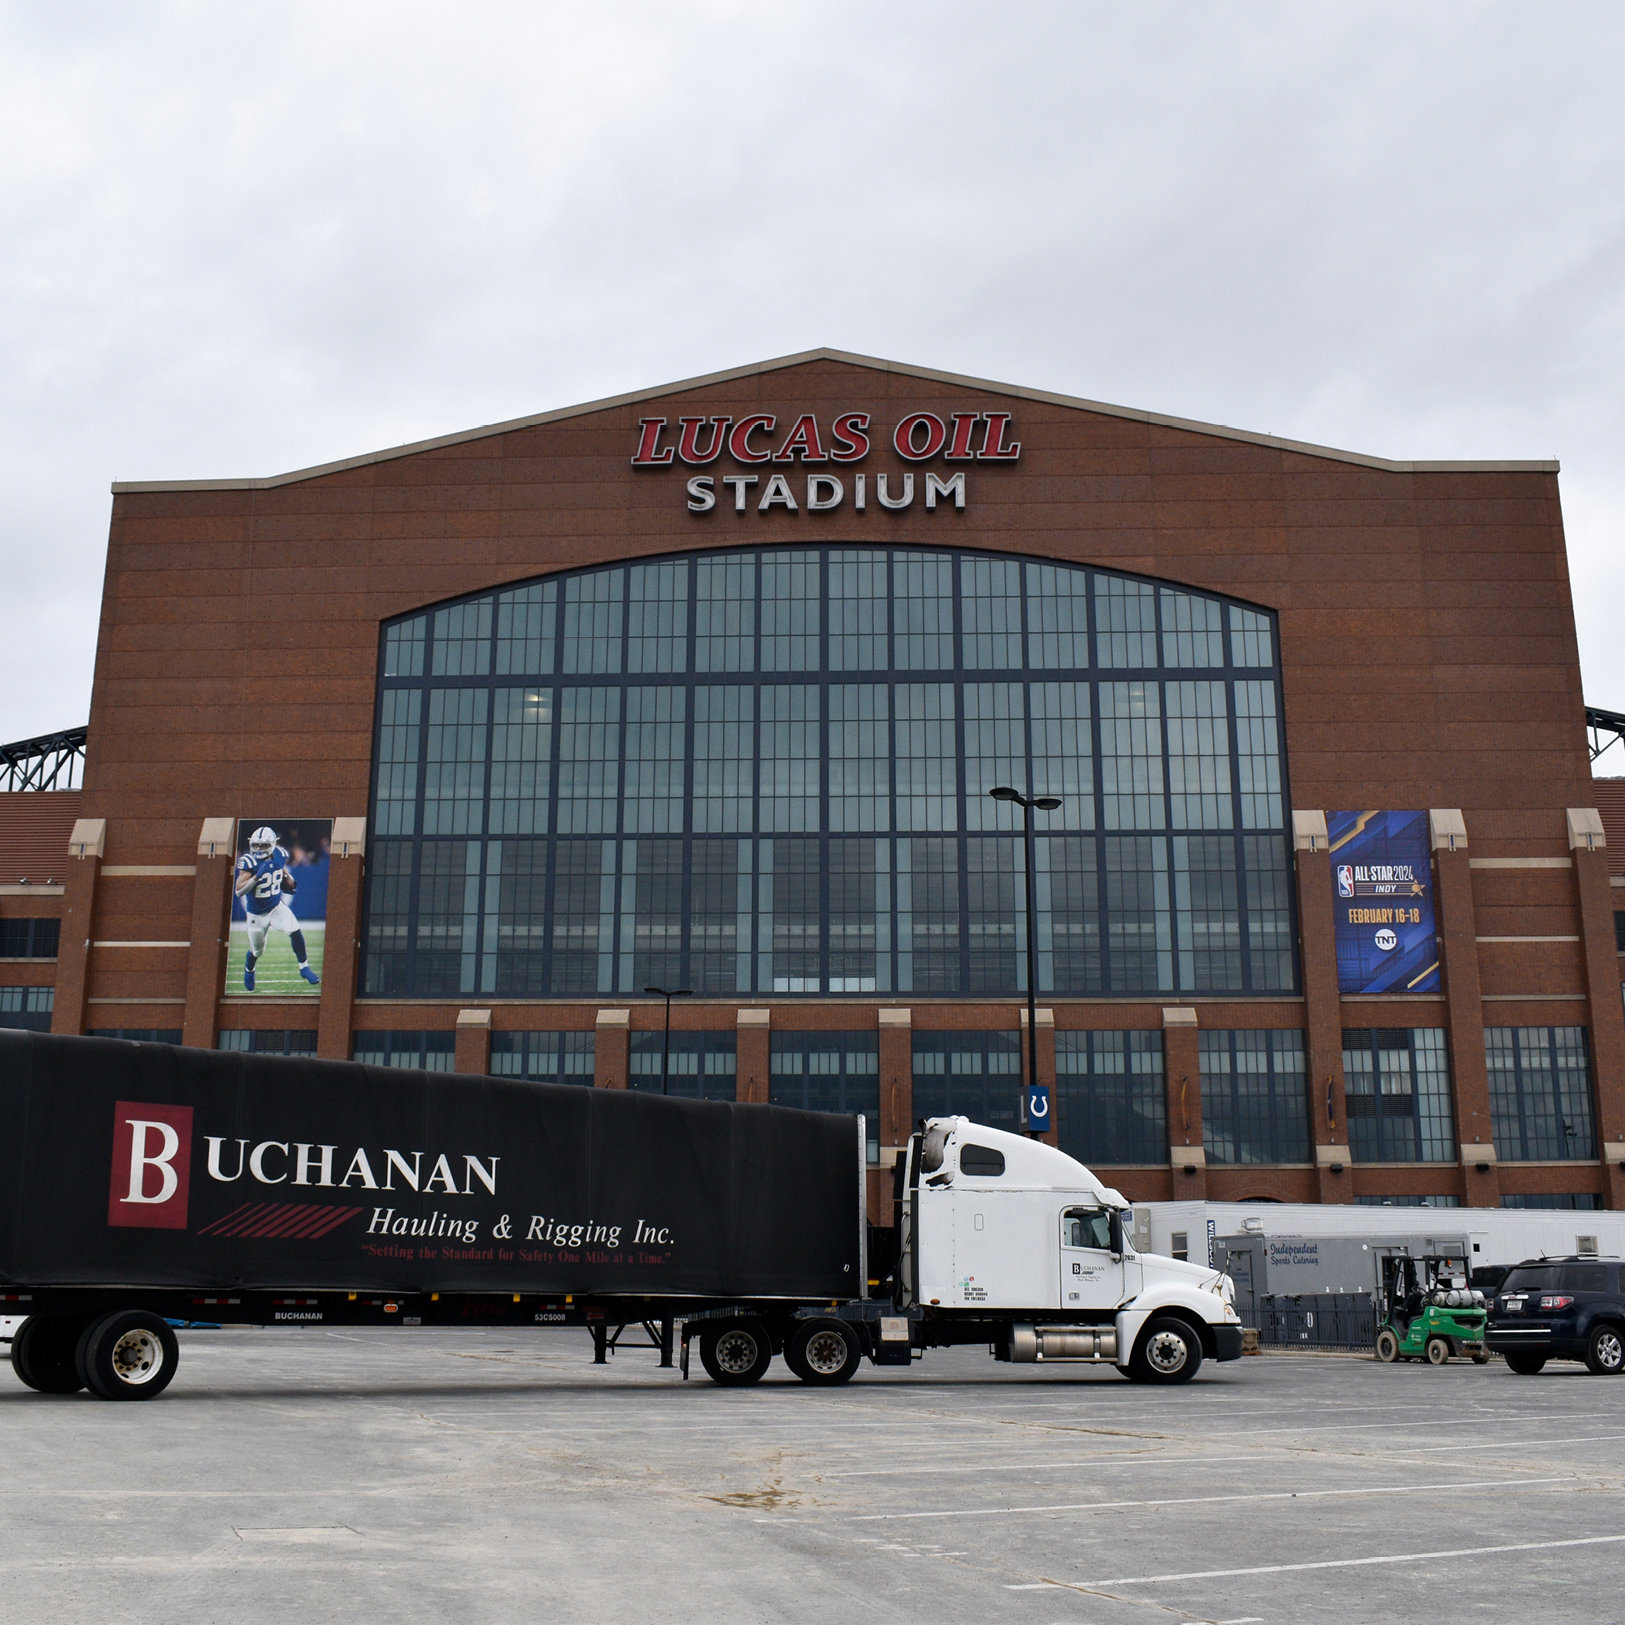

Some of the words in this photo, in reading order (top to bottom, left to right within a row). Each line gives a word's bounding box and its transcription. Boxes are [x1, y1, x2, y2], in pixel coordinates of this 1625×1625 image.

[631, 412, 871, 465] LUCAS
[893, 411, 1021, 463] OIL
[686, 472, 966, 513] STADIUM
[1393, 865, 1413, 881] 2024
[255, 868, 283, 898] 28
[1375, 885, 1397, 893] INDY
[1348, 908, 1393, 924] FEBRUARY
[1395, 908, 1420, 923] 16-18
[1375, 936, 1397, 945] TNT
[119, 1119, 500, 1204] BUCHANAN
[365, 1206, 479, 1244] Hauling
[492, 1213, 513, 1240] &
[525, 1215, 622, 1248] Rigging
[632, 1219, 676, 1244] Inc.
[419, 1246, 438, 1259] the
[441, 1246, 493, 1260] Standard
[498, 1248, 515, 1260] for
[519, 1249, 553, 1264] Safety
[558, 1250, 581, 1263] One
[585, 1251, 610, 1264] Mile
[613, 1252, 624, 1264] at
[1270, 1243, 1318, 1256] Independent
[1270, 1256, 1291, 1266] Sports
[1292, 1255, 1319, 1266] Catering
[1073, 1264, 1105, 1274] BUCHANAN
[274, 1312, 323, 1320] BUCHANAN
